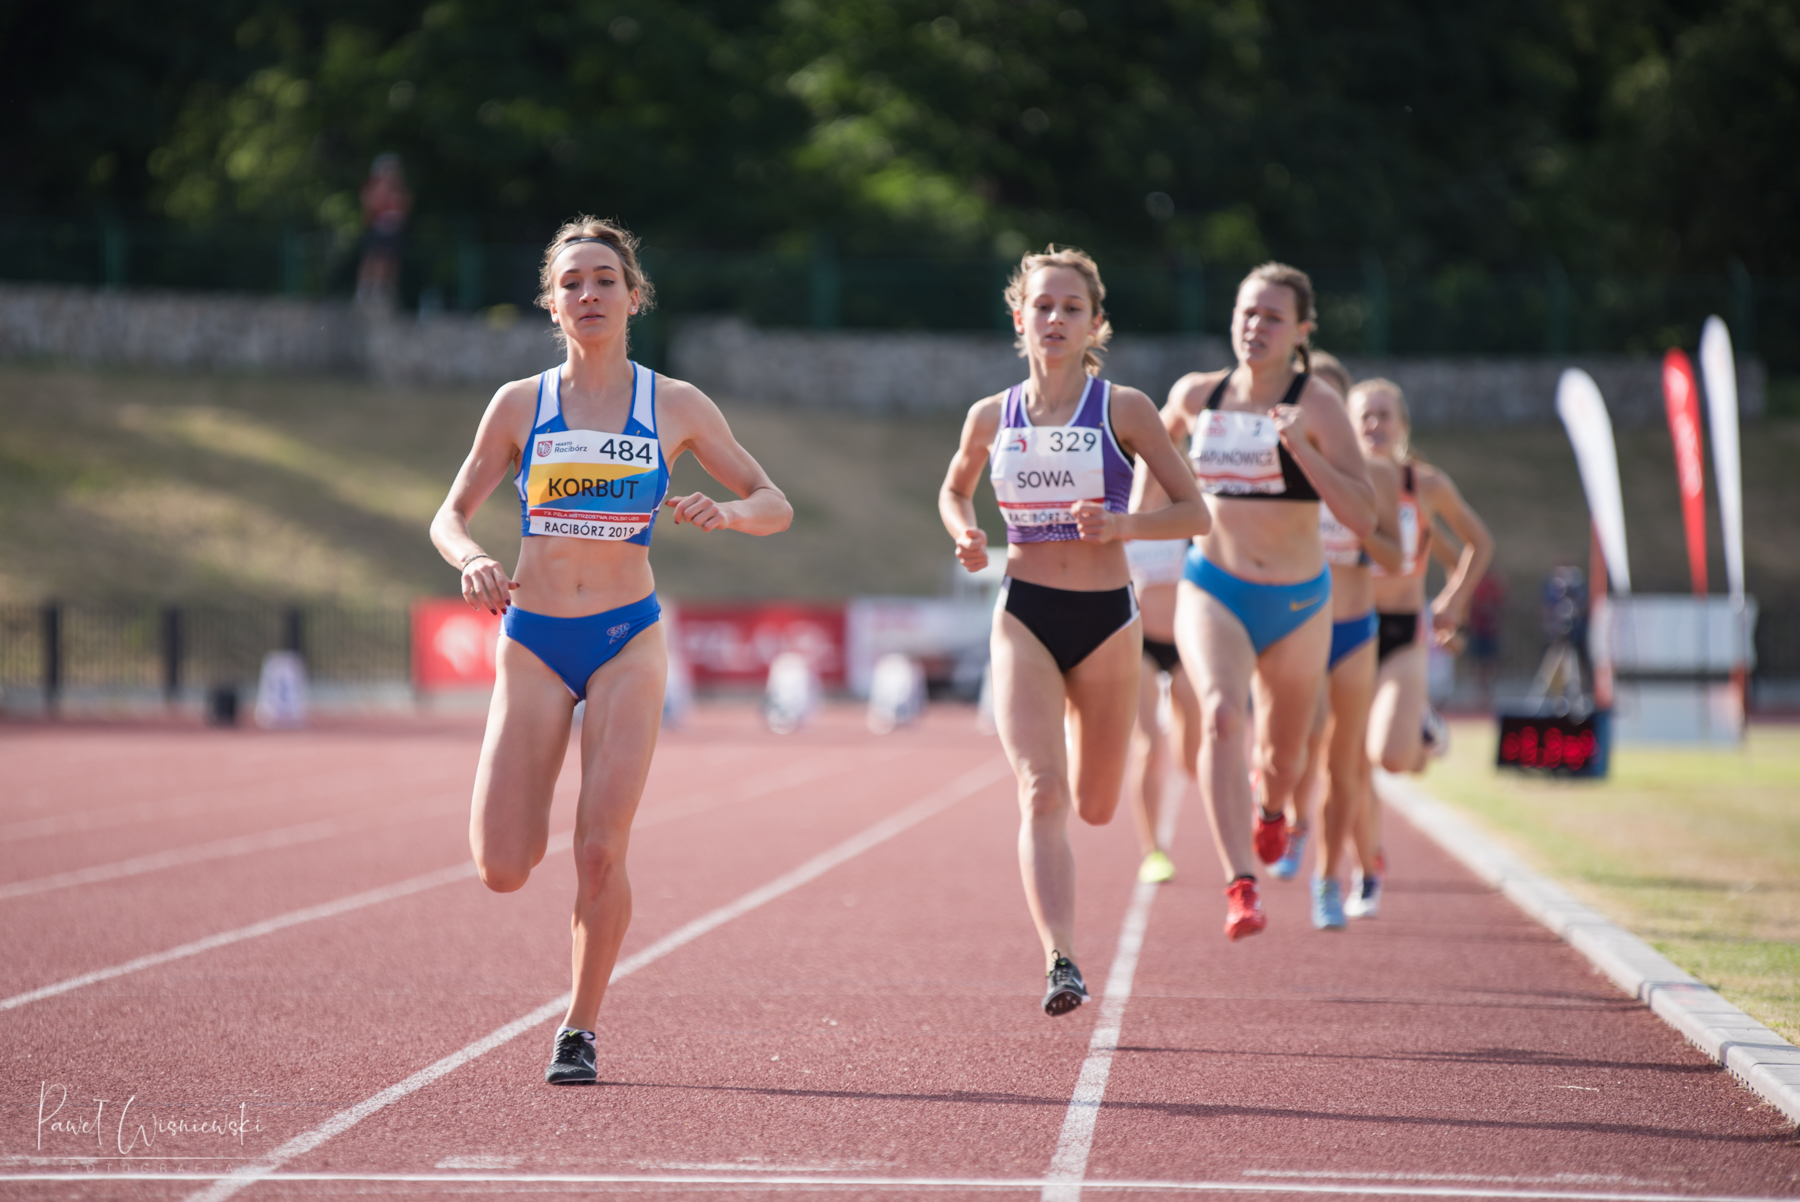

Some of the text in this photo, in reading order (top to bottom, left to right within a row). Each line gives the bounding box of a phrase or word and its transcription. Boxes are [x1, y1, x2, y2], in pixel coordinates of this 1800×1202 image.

[554, 444, 588, 453] Racibórz
[599, 438, 653, 464] 484
[1050, 431, 1097, 452] 329
[1198, 449, 1273, 467] ARUNOWICZ
[548, 478, 639, 500] KORBUT
[1017, 470, 1076, 489] SOWA
[544, 521, 635, 538] RACIBÓRZ 2019
